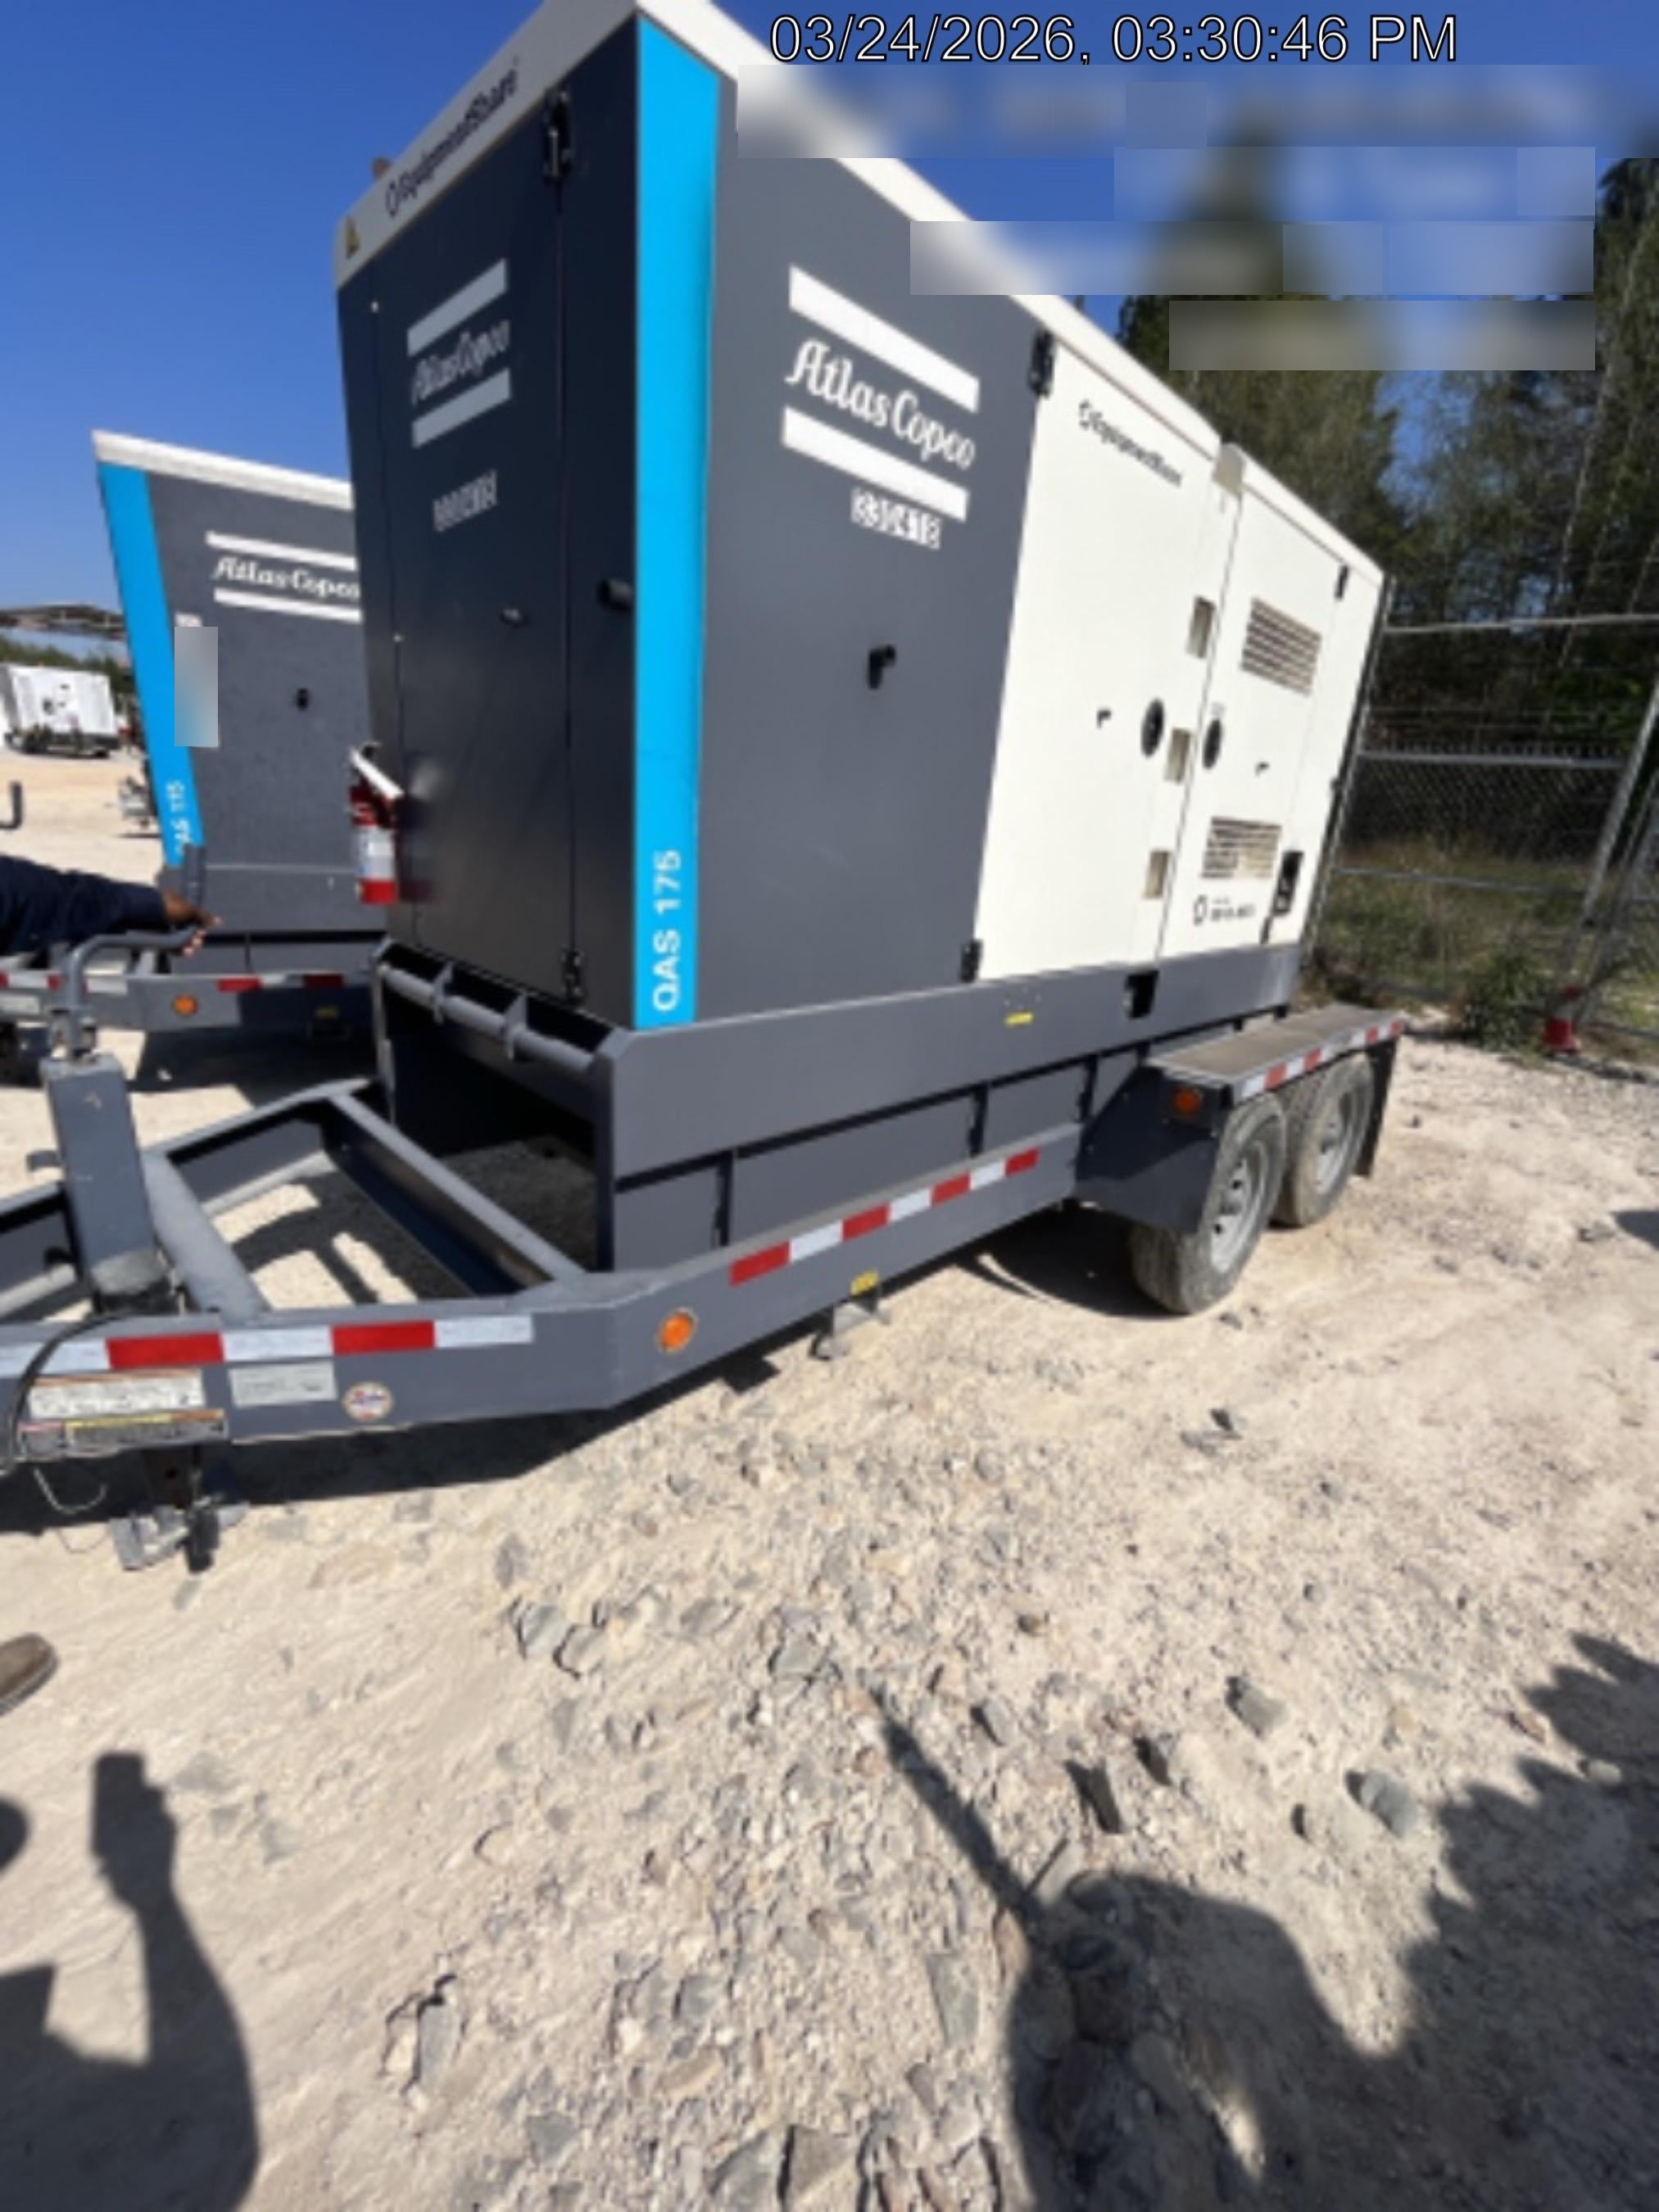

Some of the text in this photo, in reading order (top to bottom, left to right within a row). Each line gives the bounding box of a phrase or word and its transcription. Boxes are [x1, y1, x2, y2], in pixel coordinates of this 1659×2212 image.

[784, 337, 977, 470] Atlas Copco
[211, 556, 286, 589] Atlas
[652, 849, 683, 1013] QAS 175
